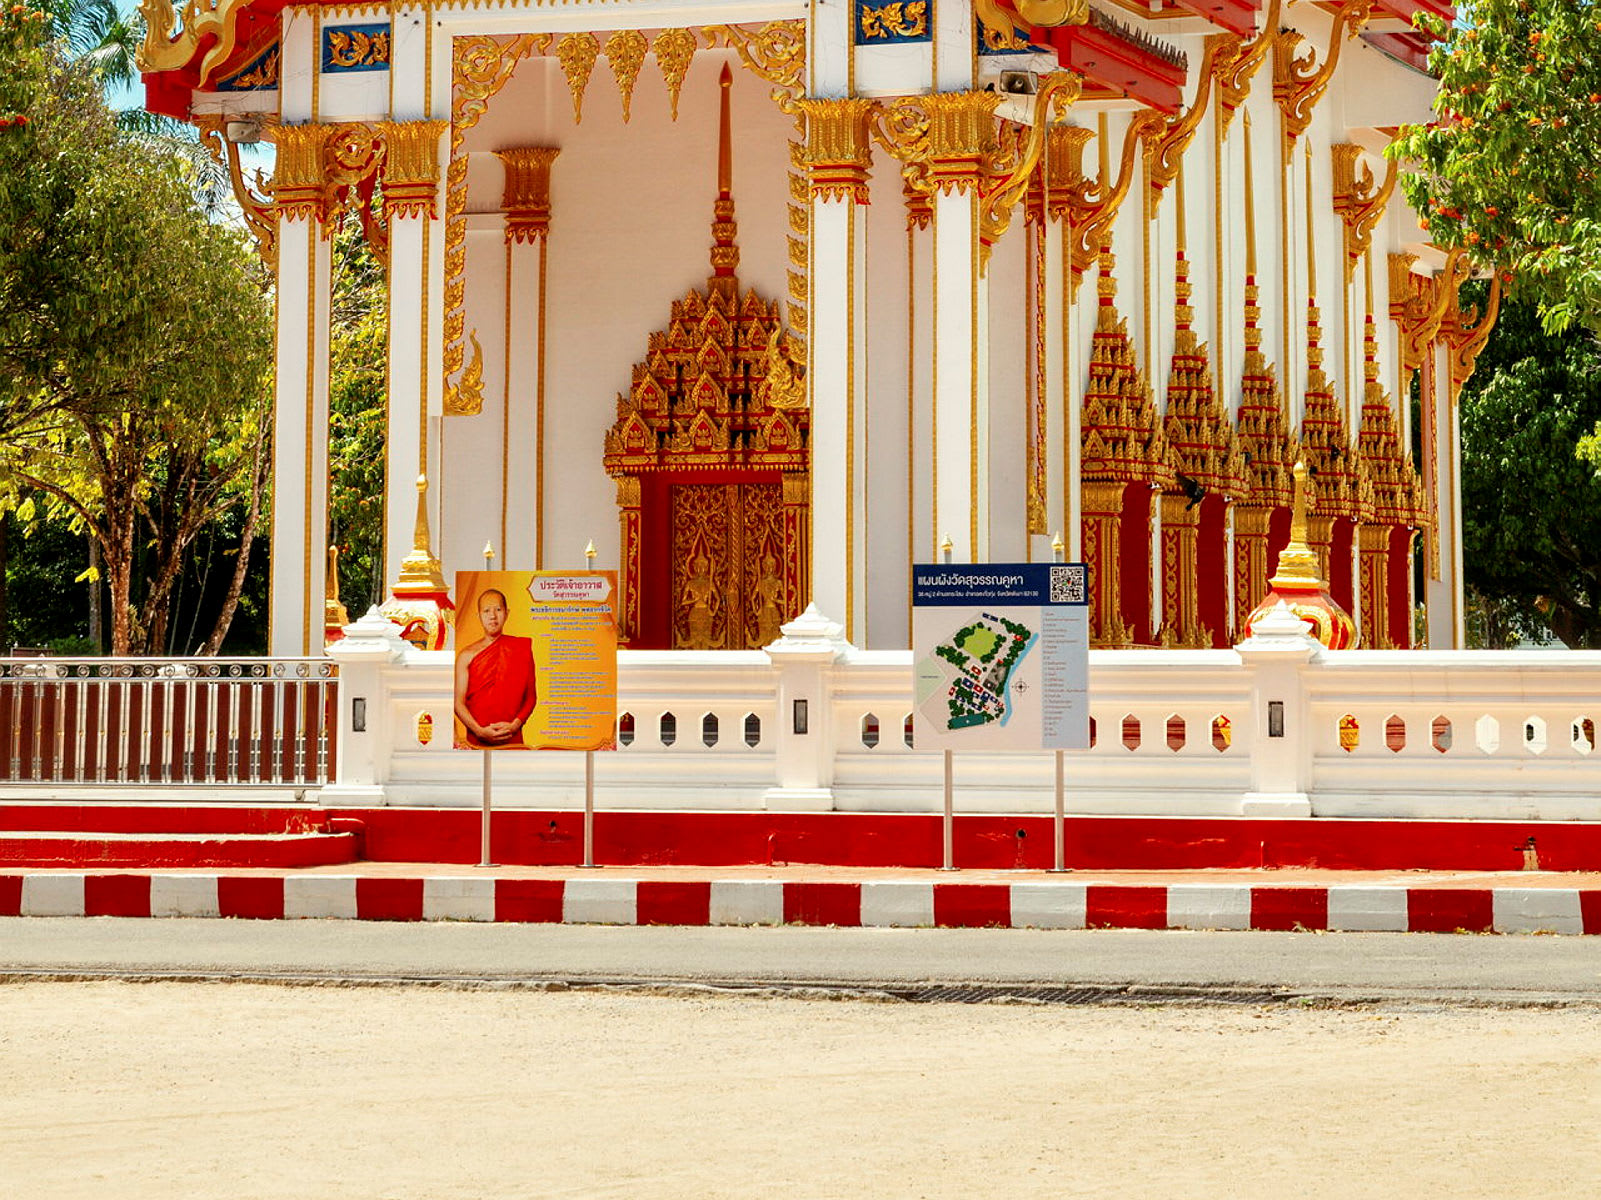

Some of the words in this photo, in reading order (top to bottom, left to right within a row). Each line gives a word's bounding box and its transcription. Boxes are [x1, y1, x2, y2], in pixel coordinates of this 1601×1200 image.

[540, 579, 603, 590] ประวัติเจ้าอาวาส
[917, 573, 1024, 589] แผนผังวัดสุวรรณคูหา
